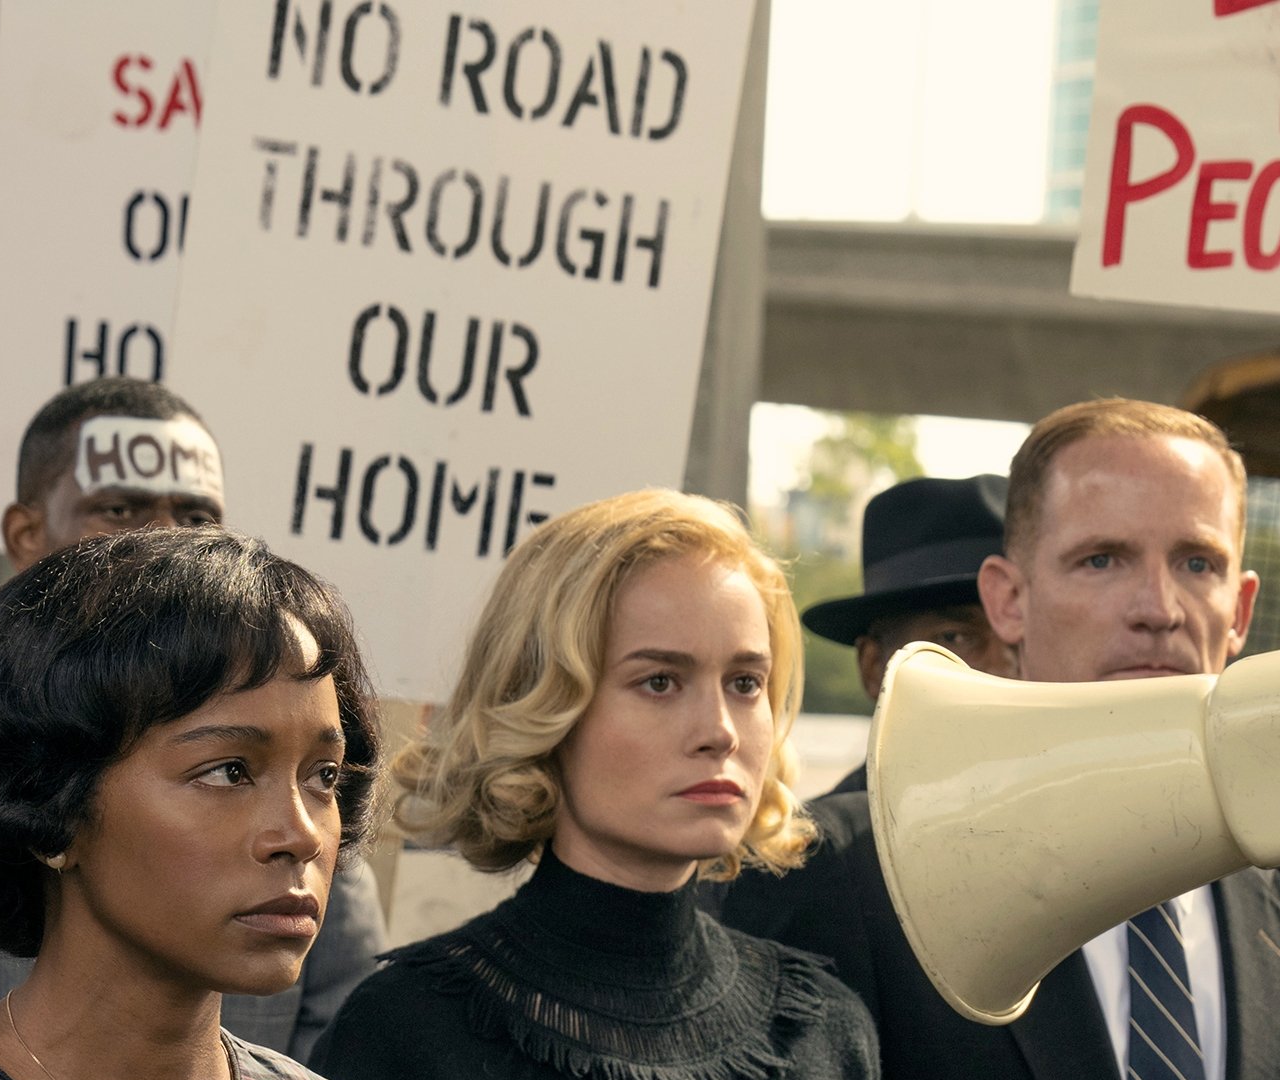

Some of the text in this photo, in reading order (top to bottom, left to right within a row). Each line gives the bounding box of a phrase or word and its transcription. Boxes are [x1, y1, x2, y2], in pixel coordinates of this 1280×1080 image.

[268, 0, 689, 141] NO ROAD
[124, 189, 190, 262] O
[253, 135, 671, 289] THROUGH
[64, 317, 164, 385] HO
[348, 303, 541, 417] OUR
[291, 442, 556, 559] HOME
